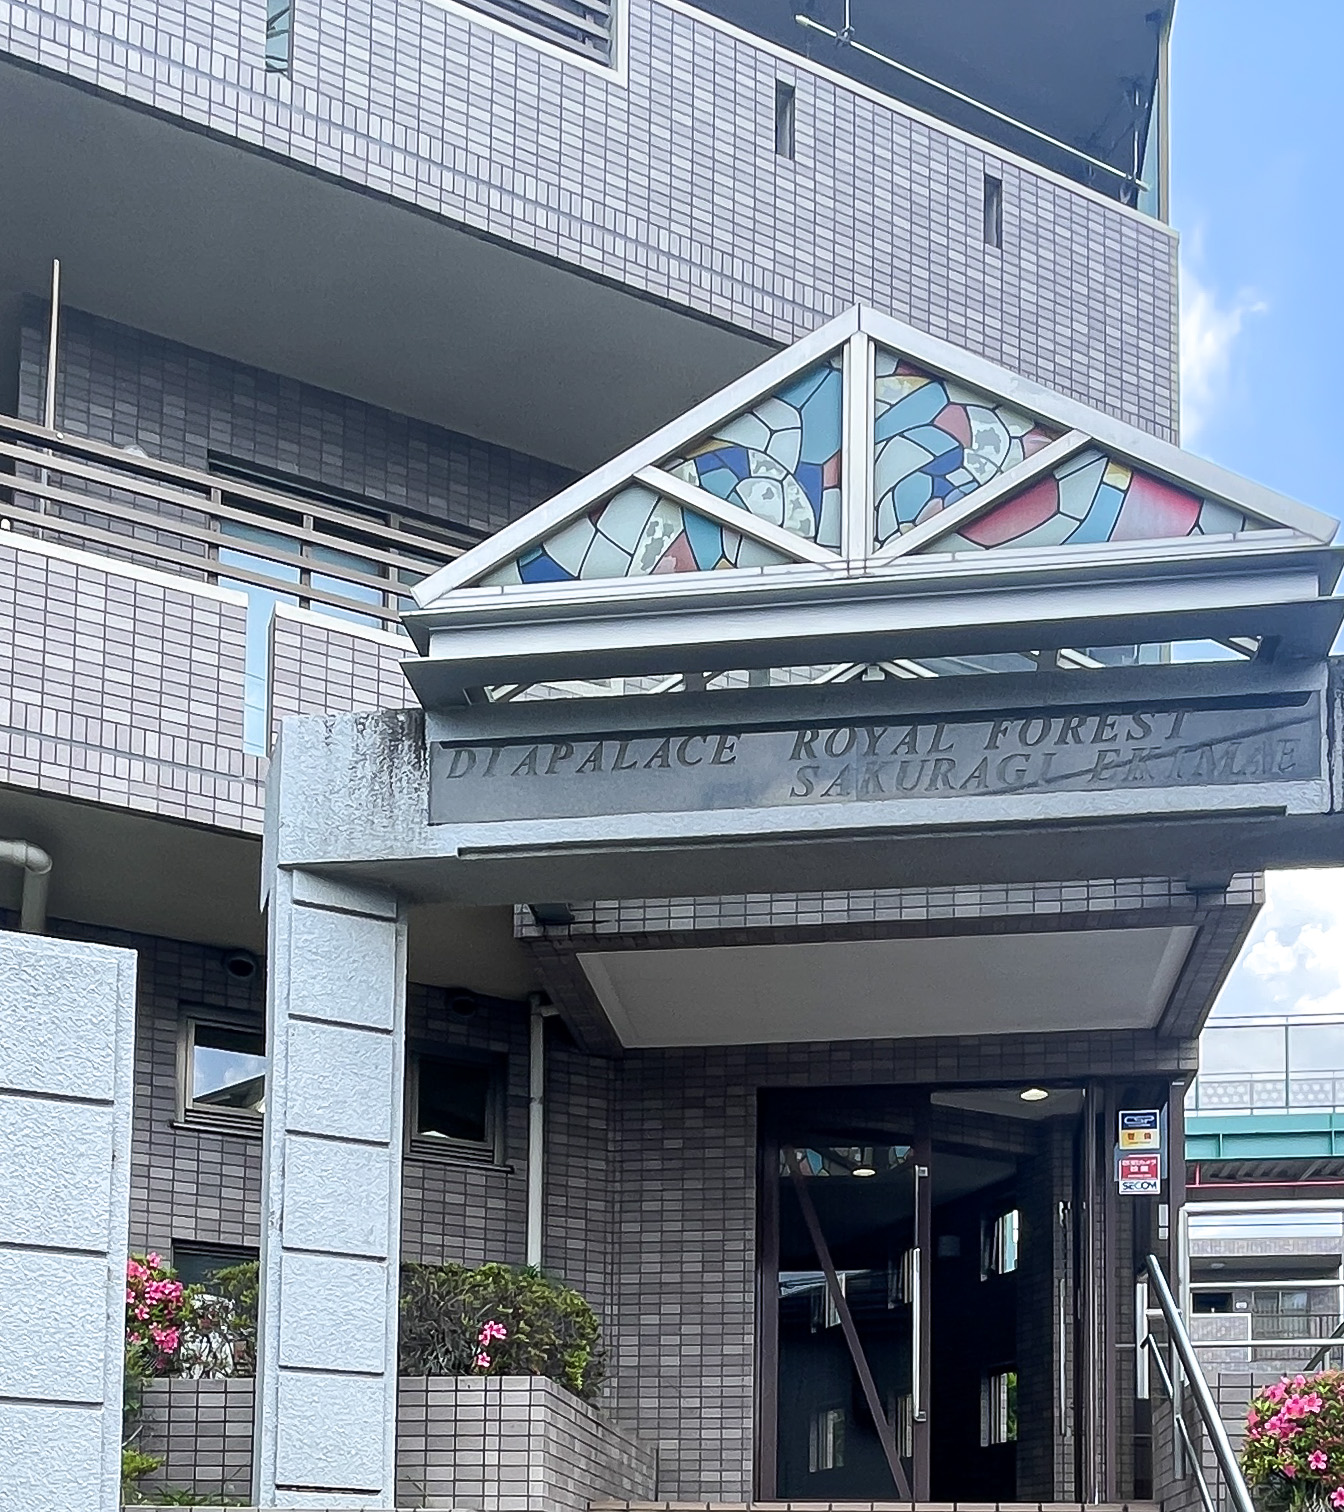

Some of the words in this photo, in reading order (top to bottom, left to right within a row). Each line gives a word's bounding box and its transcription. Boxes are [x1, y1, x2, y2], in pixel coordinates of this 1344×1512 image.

[789, 723, 955, 762] ROYAL
[984, 709, 1193, 751] FOREST
[789, 752, 1058, 798] SAKURAGI
[1122, 1181, 1157, 1190] SECOM
